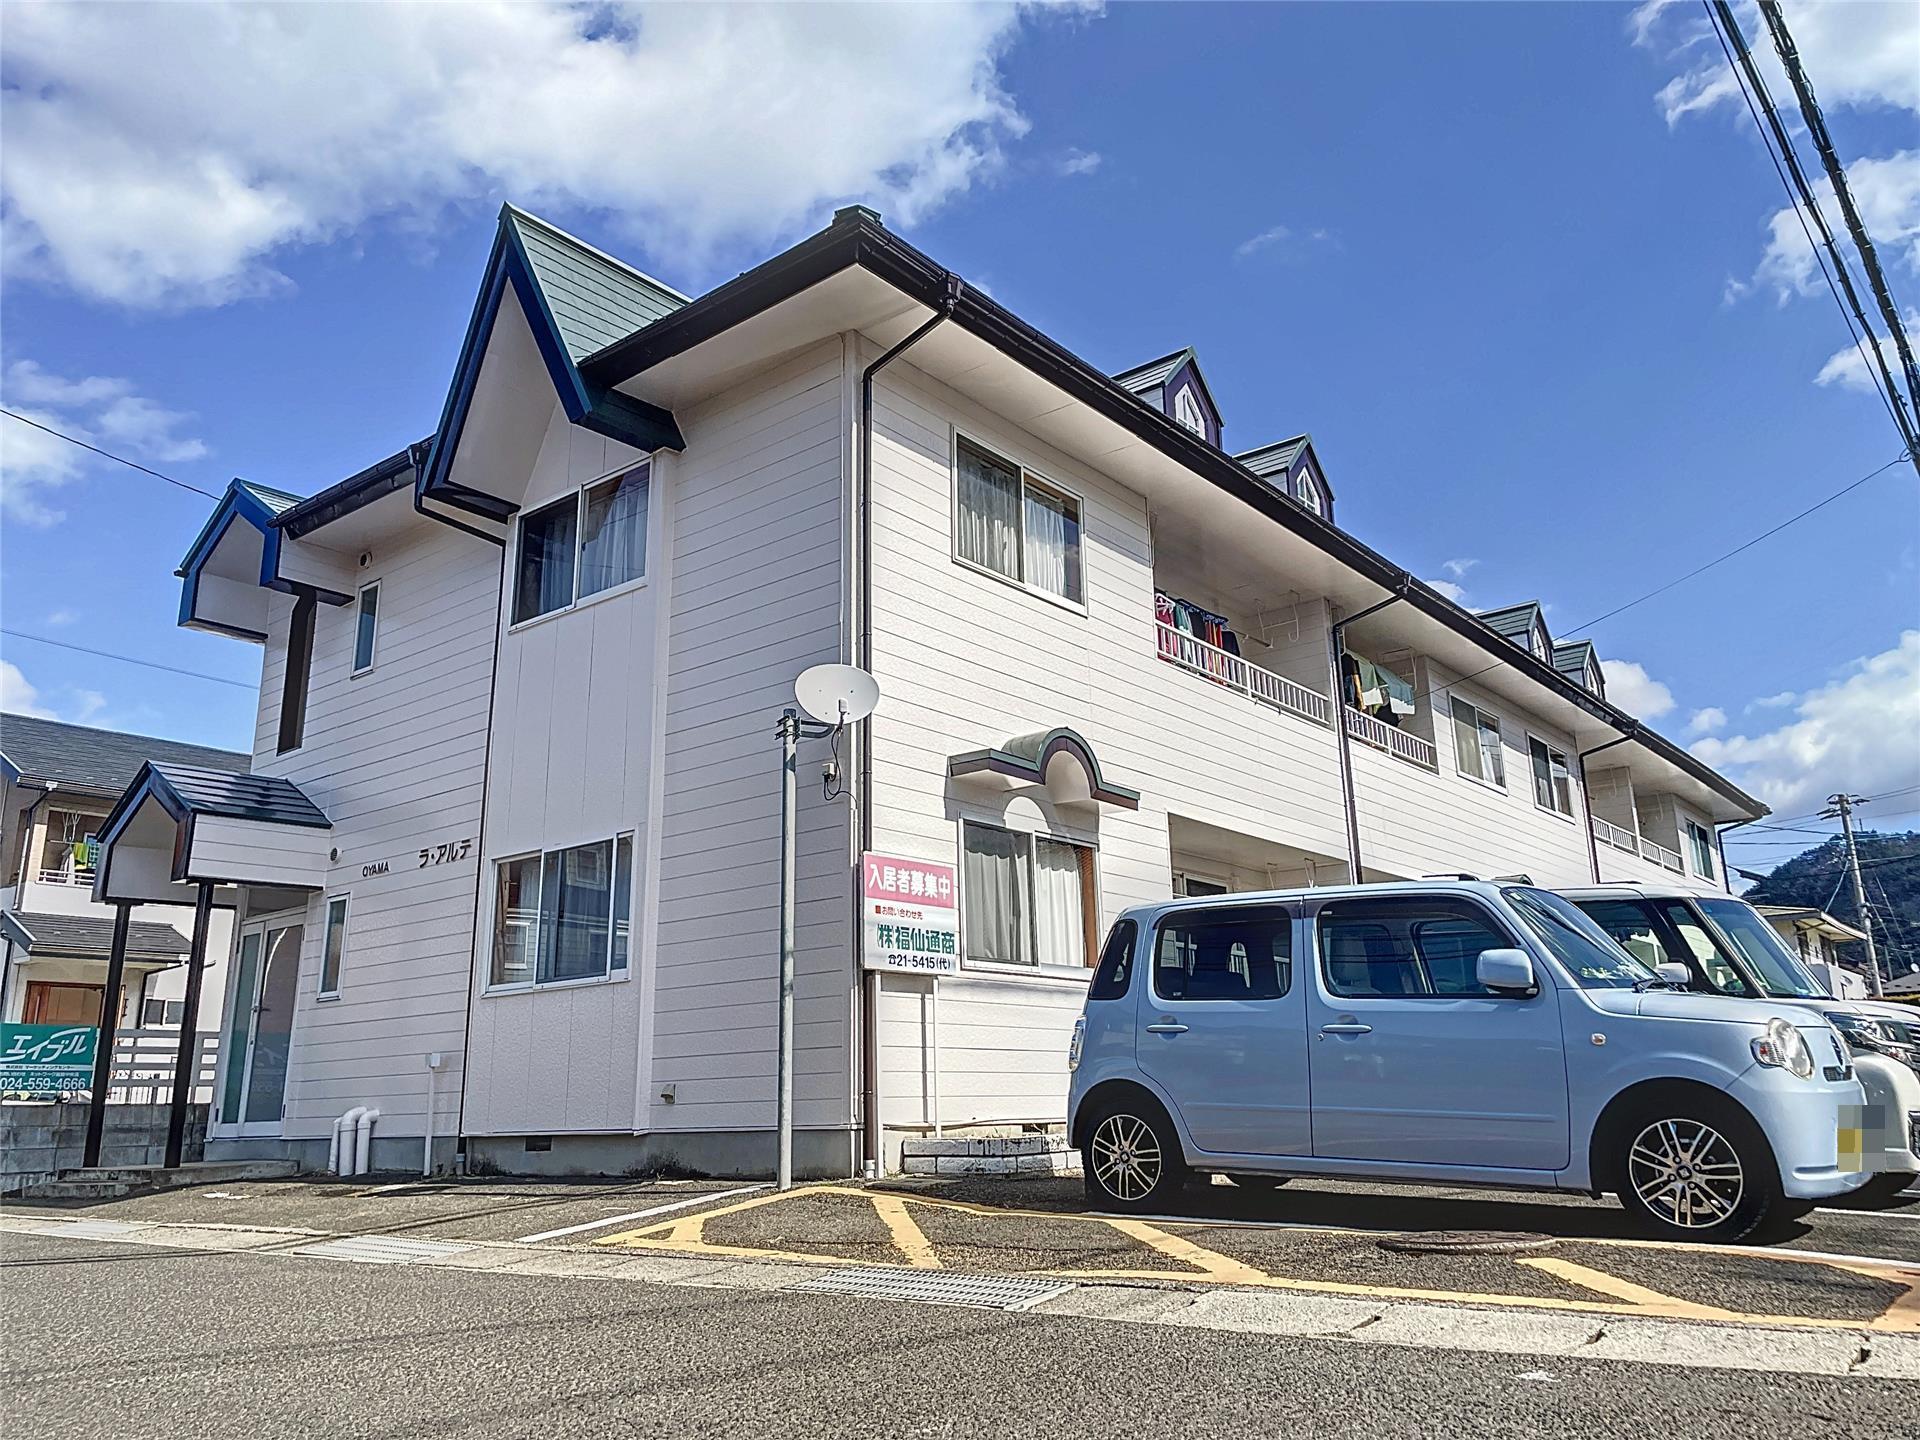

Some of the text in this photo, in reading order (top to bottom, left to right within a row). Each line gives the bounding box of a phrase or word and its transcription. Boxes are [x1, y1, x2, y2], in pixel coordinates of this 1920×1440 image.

[418, 839, 472, 868] ラ・アルテ
[362, 862, 390, 877] OYAMA
[868, 863, 951, 900] 入居者募集中
[0, 1027, 91, 1063] エイブル
[0, 1077, 86, 1090] 024-559-4666
